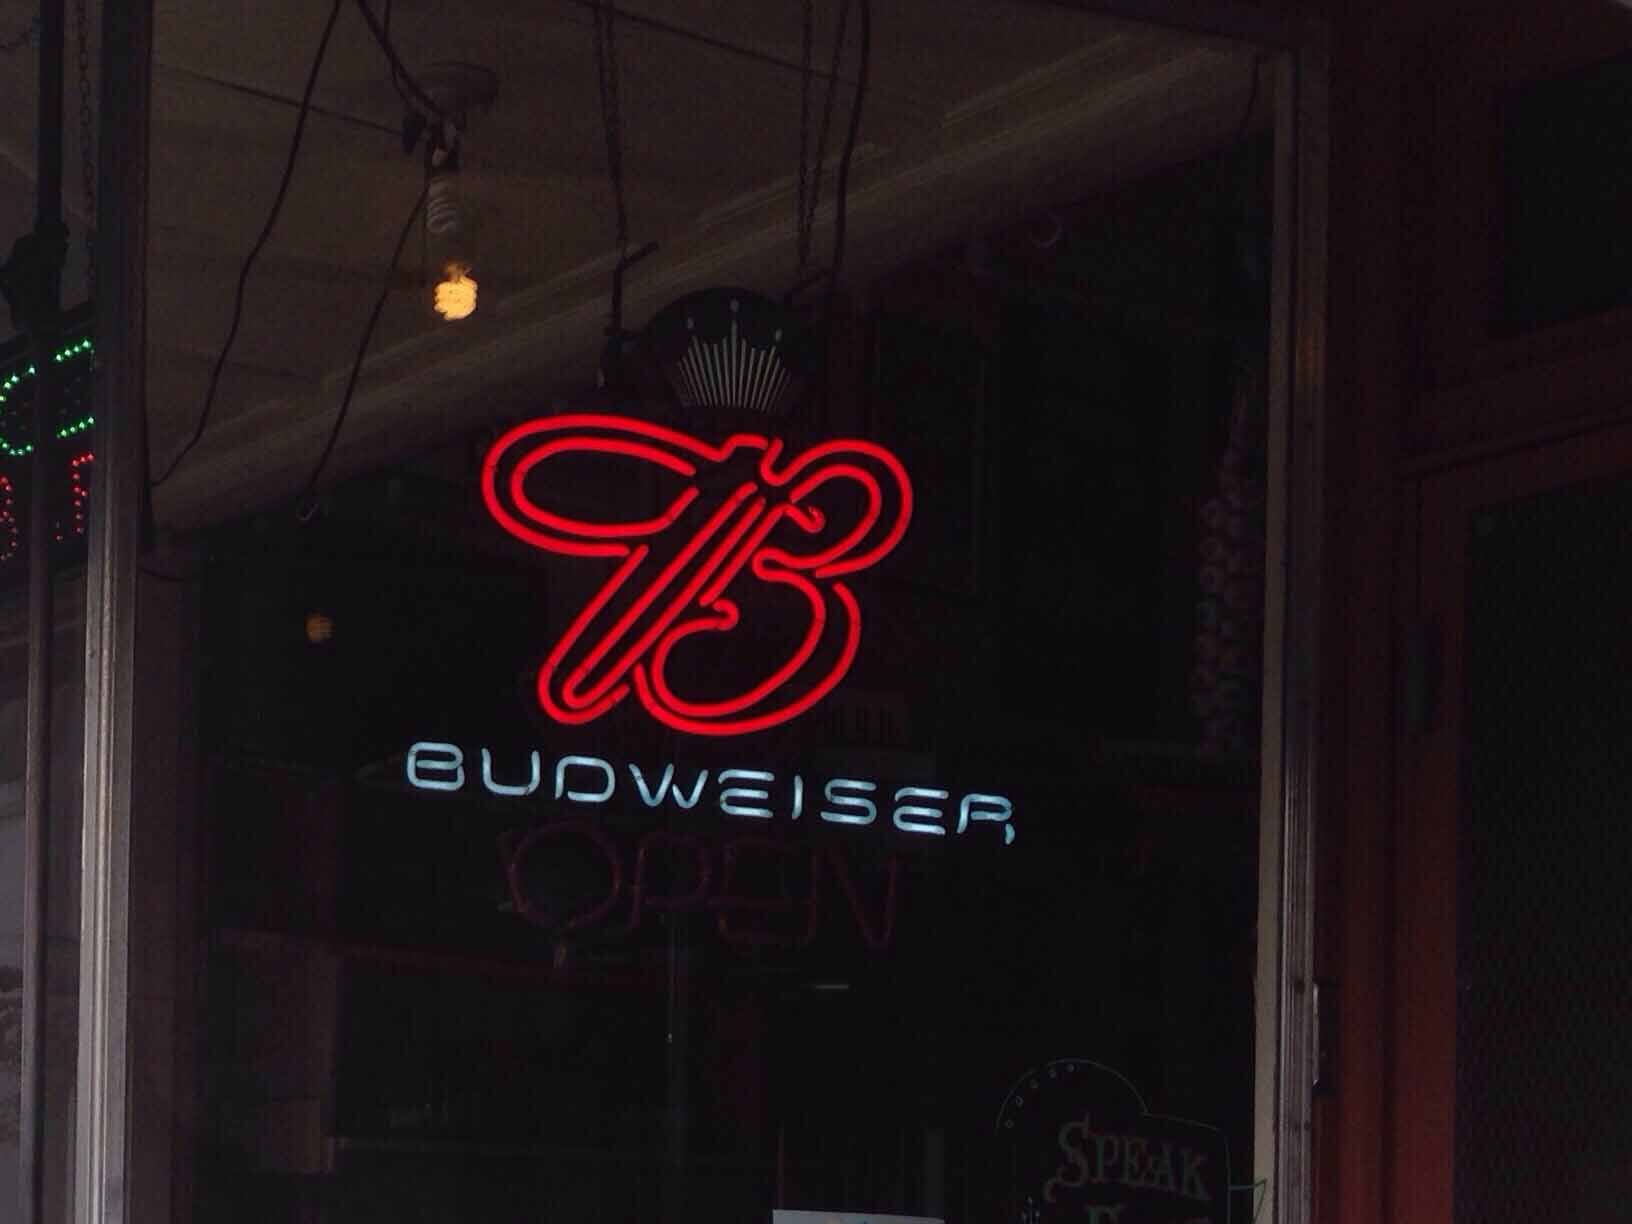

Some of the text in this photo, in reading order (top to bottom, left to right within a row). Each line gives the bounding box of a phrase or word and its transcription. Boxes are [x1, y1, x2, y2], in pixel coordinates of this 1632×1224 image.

[405, 741, 1017, 846] BUDWEISER
[507, 815, 900, 960] OPEN
[1043, 1112, 1212, 1204] SPEAK
